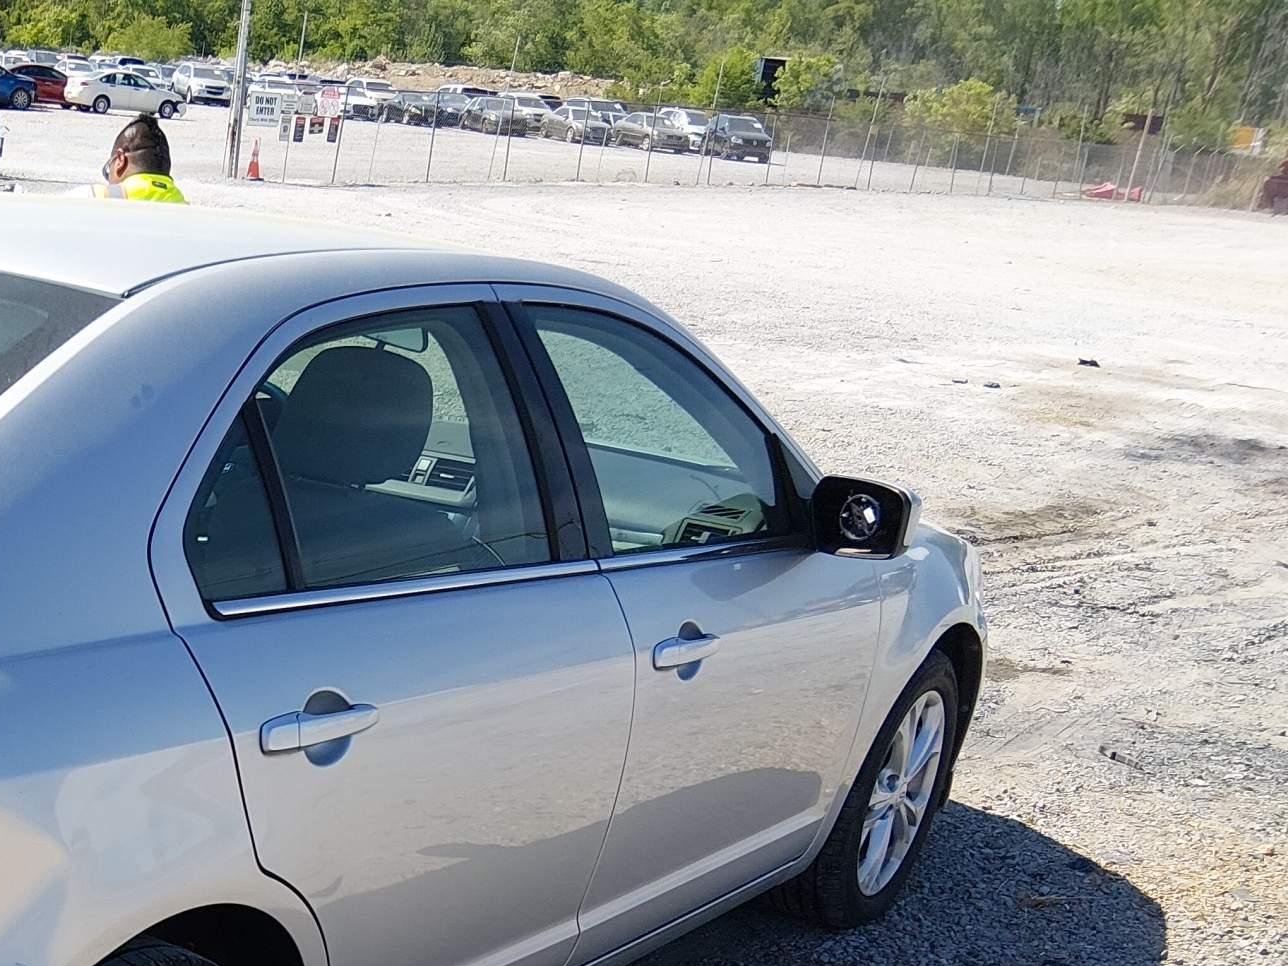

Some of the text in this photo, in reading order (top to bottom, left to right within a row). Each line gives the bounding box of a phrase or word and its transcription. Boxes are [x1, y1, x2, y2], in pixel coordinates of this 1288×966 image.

[255, 96, 264, 105] DO
[265, 97, 277, 106] NOT
[256, 106, 274, 116] ENTER
